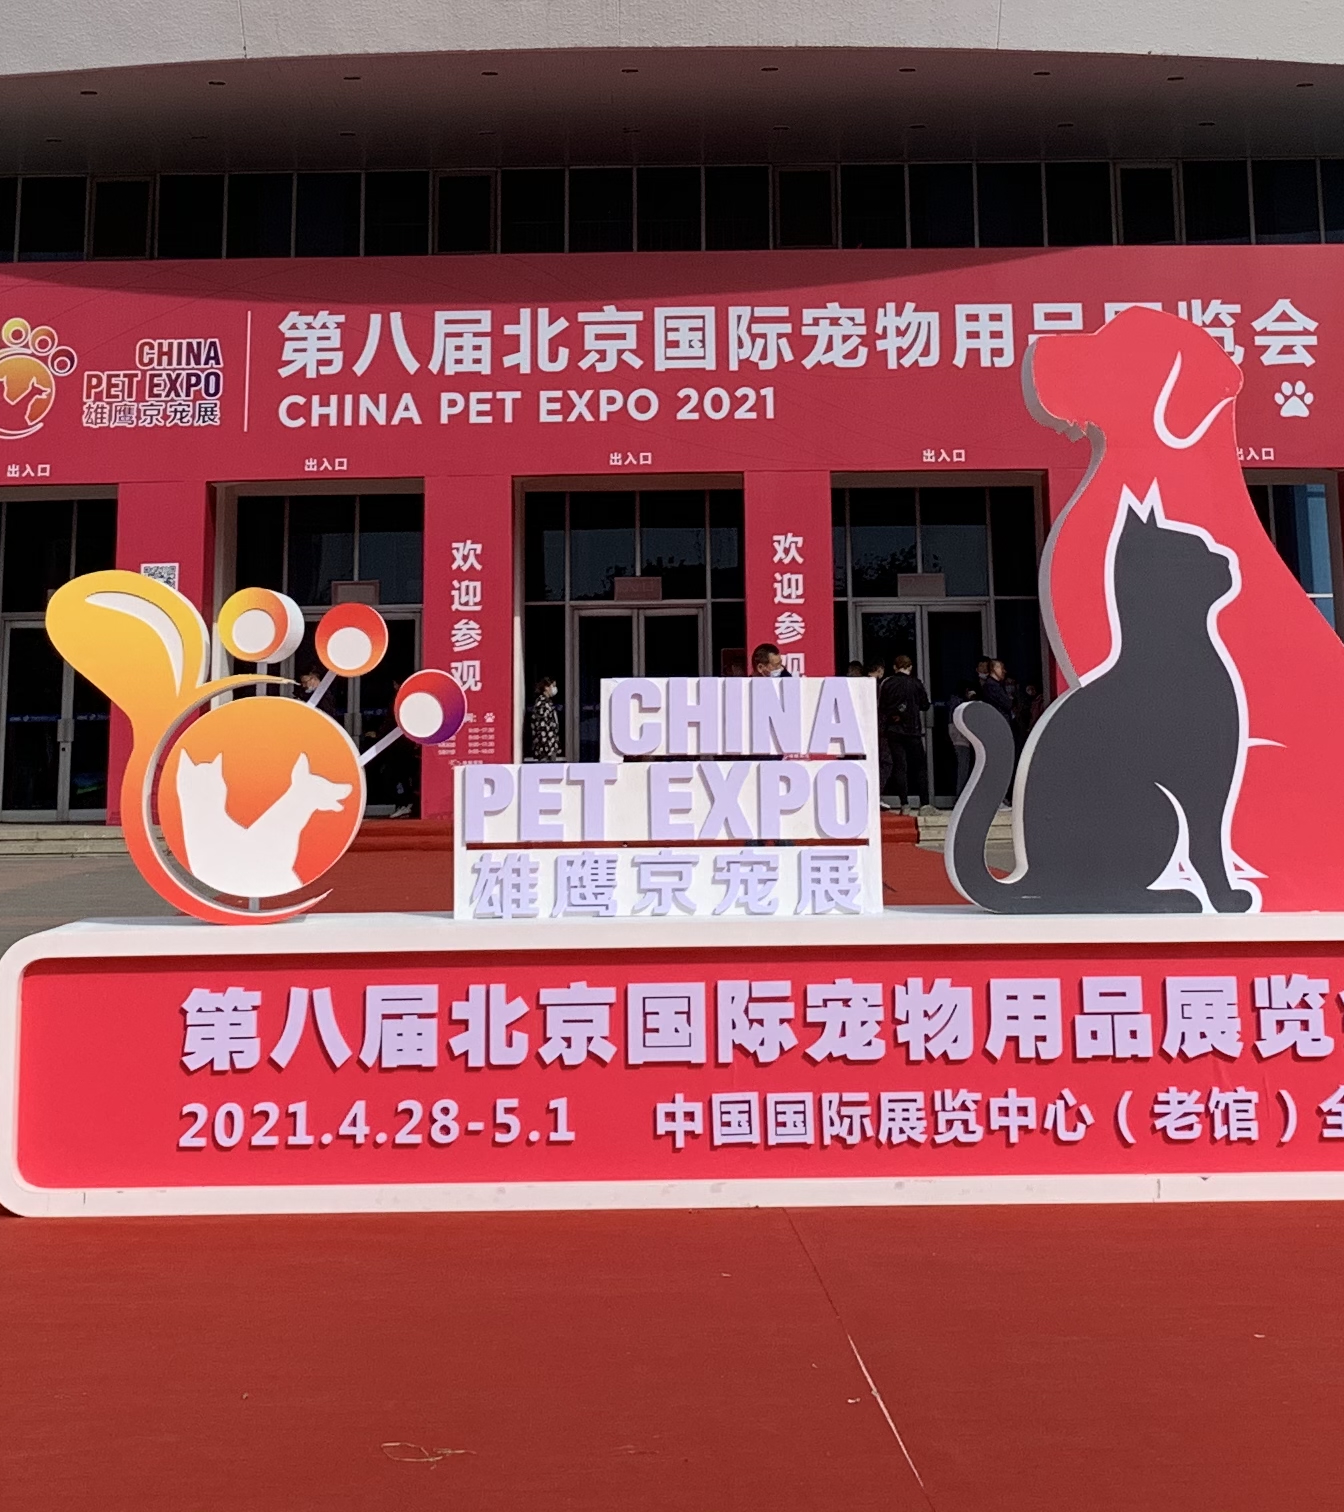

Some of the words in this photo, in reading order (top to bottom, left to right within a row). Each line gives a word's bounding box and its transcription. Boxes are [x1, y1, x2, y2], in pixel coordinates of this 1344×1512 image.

[136, 338, 223, 369] CHINA
[84, 371, 141, 402] PET
[146, 370, 223, 400] EXPO
[83, 401, 221, 428] 雄鹰京宠展
[278, 393, 422, 428] CHINA
[439, 390, 520, 425] PET
[538, 387, 660, 424] EXPO
[676, 386, 776, 421] 2021
[7, 464, 51, 479] 出入口
[305, 458, 348, 473] 出入口
[609, 451, 653, 467] 出入口
[923, 447, 967, 464] 出入口
[450, 539, 483, 693] 欢迎参观
[609, 678, 865, 756] CHINA
[463, 762, 617, 841] PET
[647, 760, 870, 841] EXPO
[470, 848, 863, 918] 雄鹰京宠展
[176, 1097, 577, 1150] 2021.4.28-5.1
